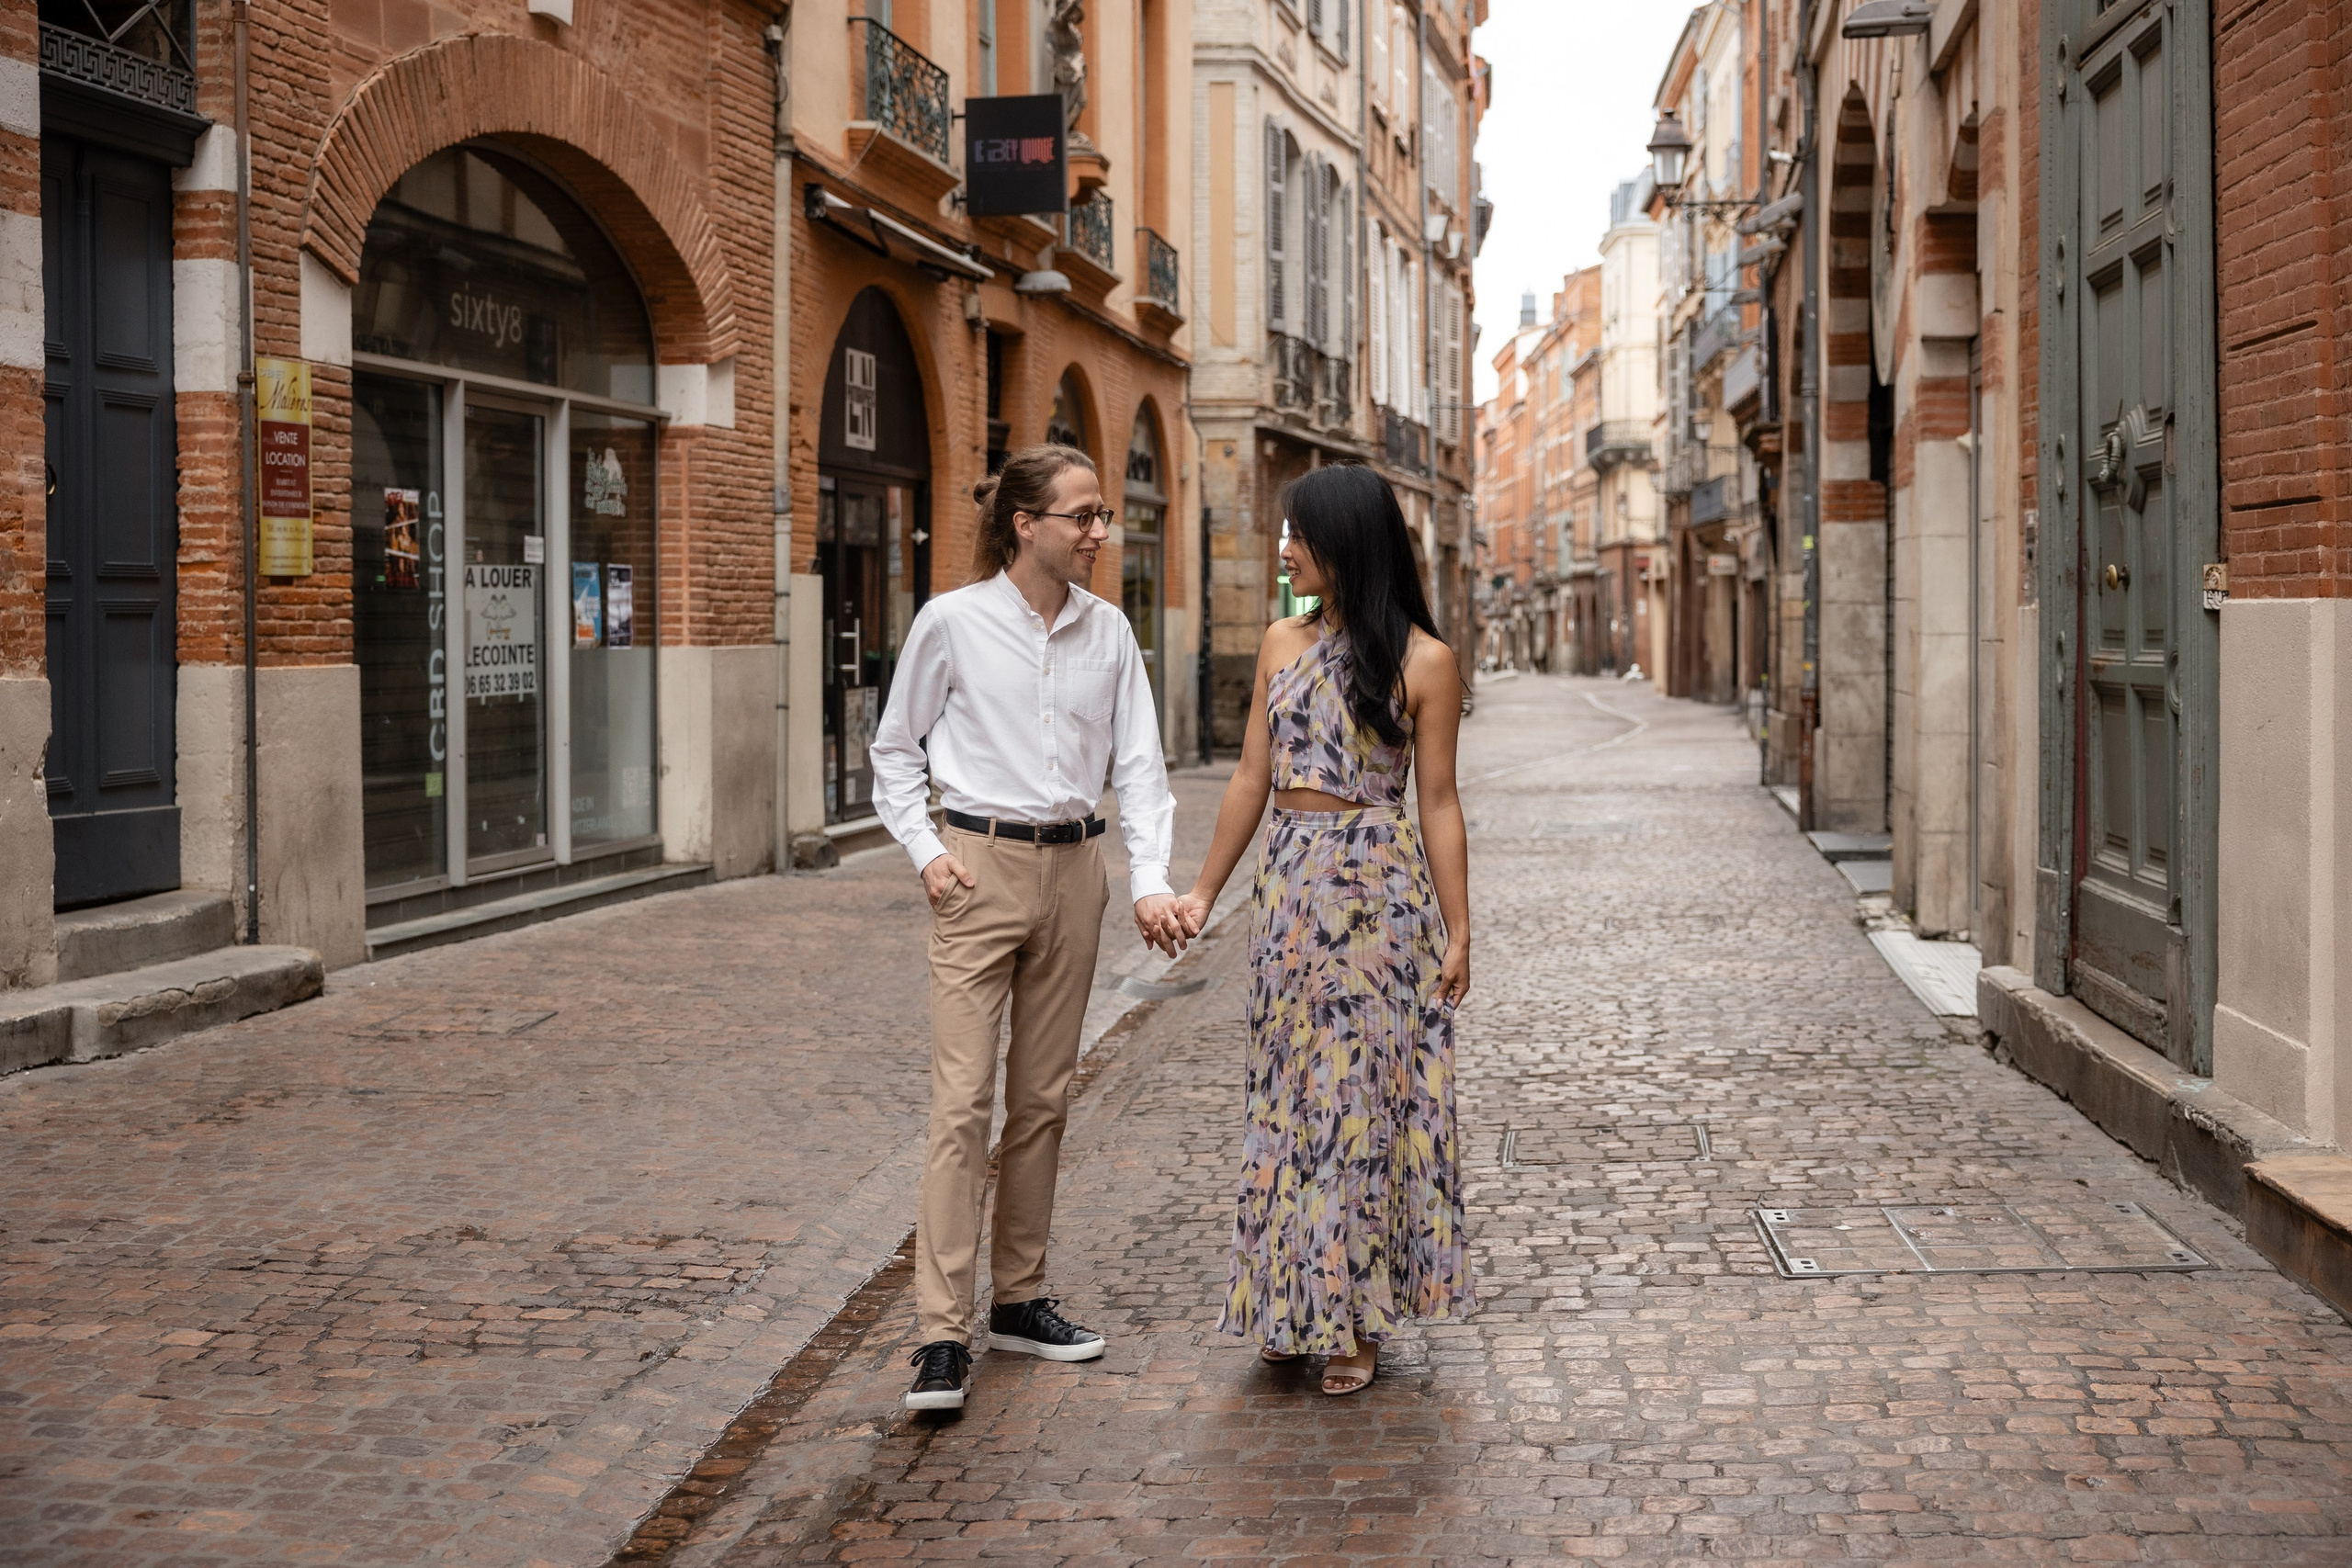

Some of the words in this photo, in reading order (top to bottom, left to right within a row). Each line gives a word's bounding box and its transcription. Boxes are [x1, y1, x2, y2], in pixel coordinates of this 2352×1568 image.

[450, 281, 522, 348] sixty8
[273, 430, 299, 446] VENTE
[265, 451, 306, 467] LOCATION
[465, 568, 475, 588] A
[481, 568, 532, 588] LOUER
[479, 674, 491, 694] 65
[493, 673, 505, 692] 32
[508, 672, 520, 691] 39
[522, 671, 535, 690] 02
